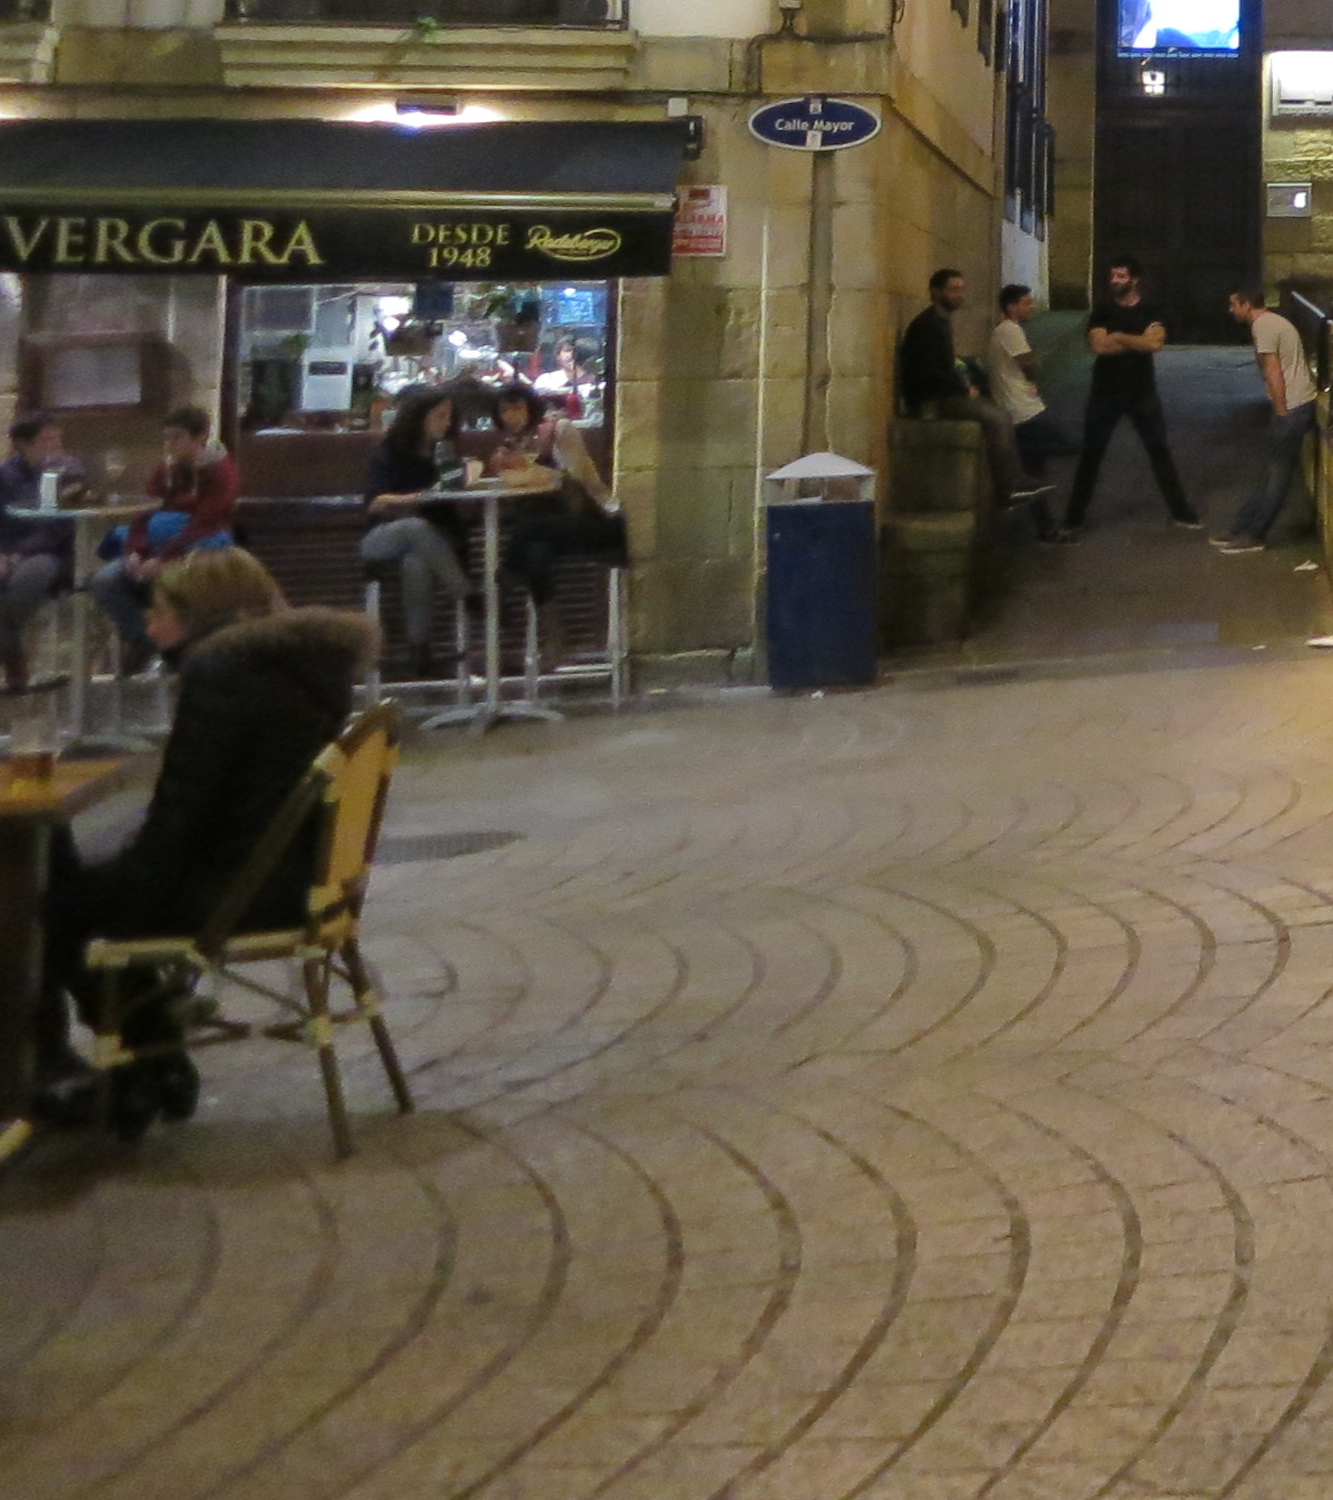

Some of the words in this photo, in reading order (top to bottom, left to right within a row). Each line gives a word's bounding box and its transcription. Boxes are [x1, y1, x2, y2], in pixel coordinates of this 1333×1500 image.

[774, 118, 808, 132] Calle
[813, 119, 855, 134] Mayor
[4, 216, 324, 265] VERGARA
[411, 223, 511, 245] DESDE
[429, 246, 492, 268] 1948
